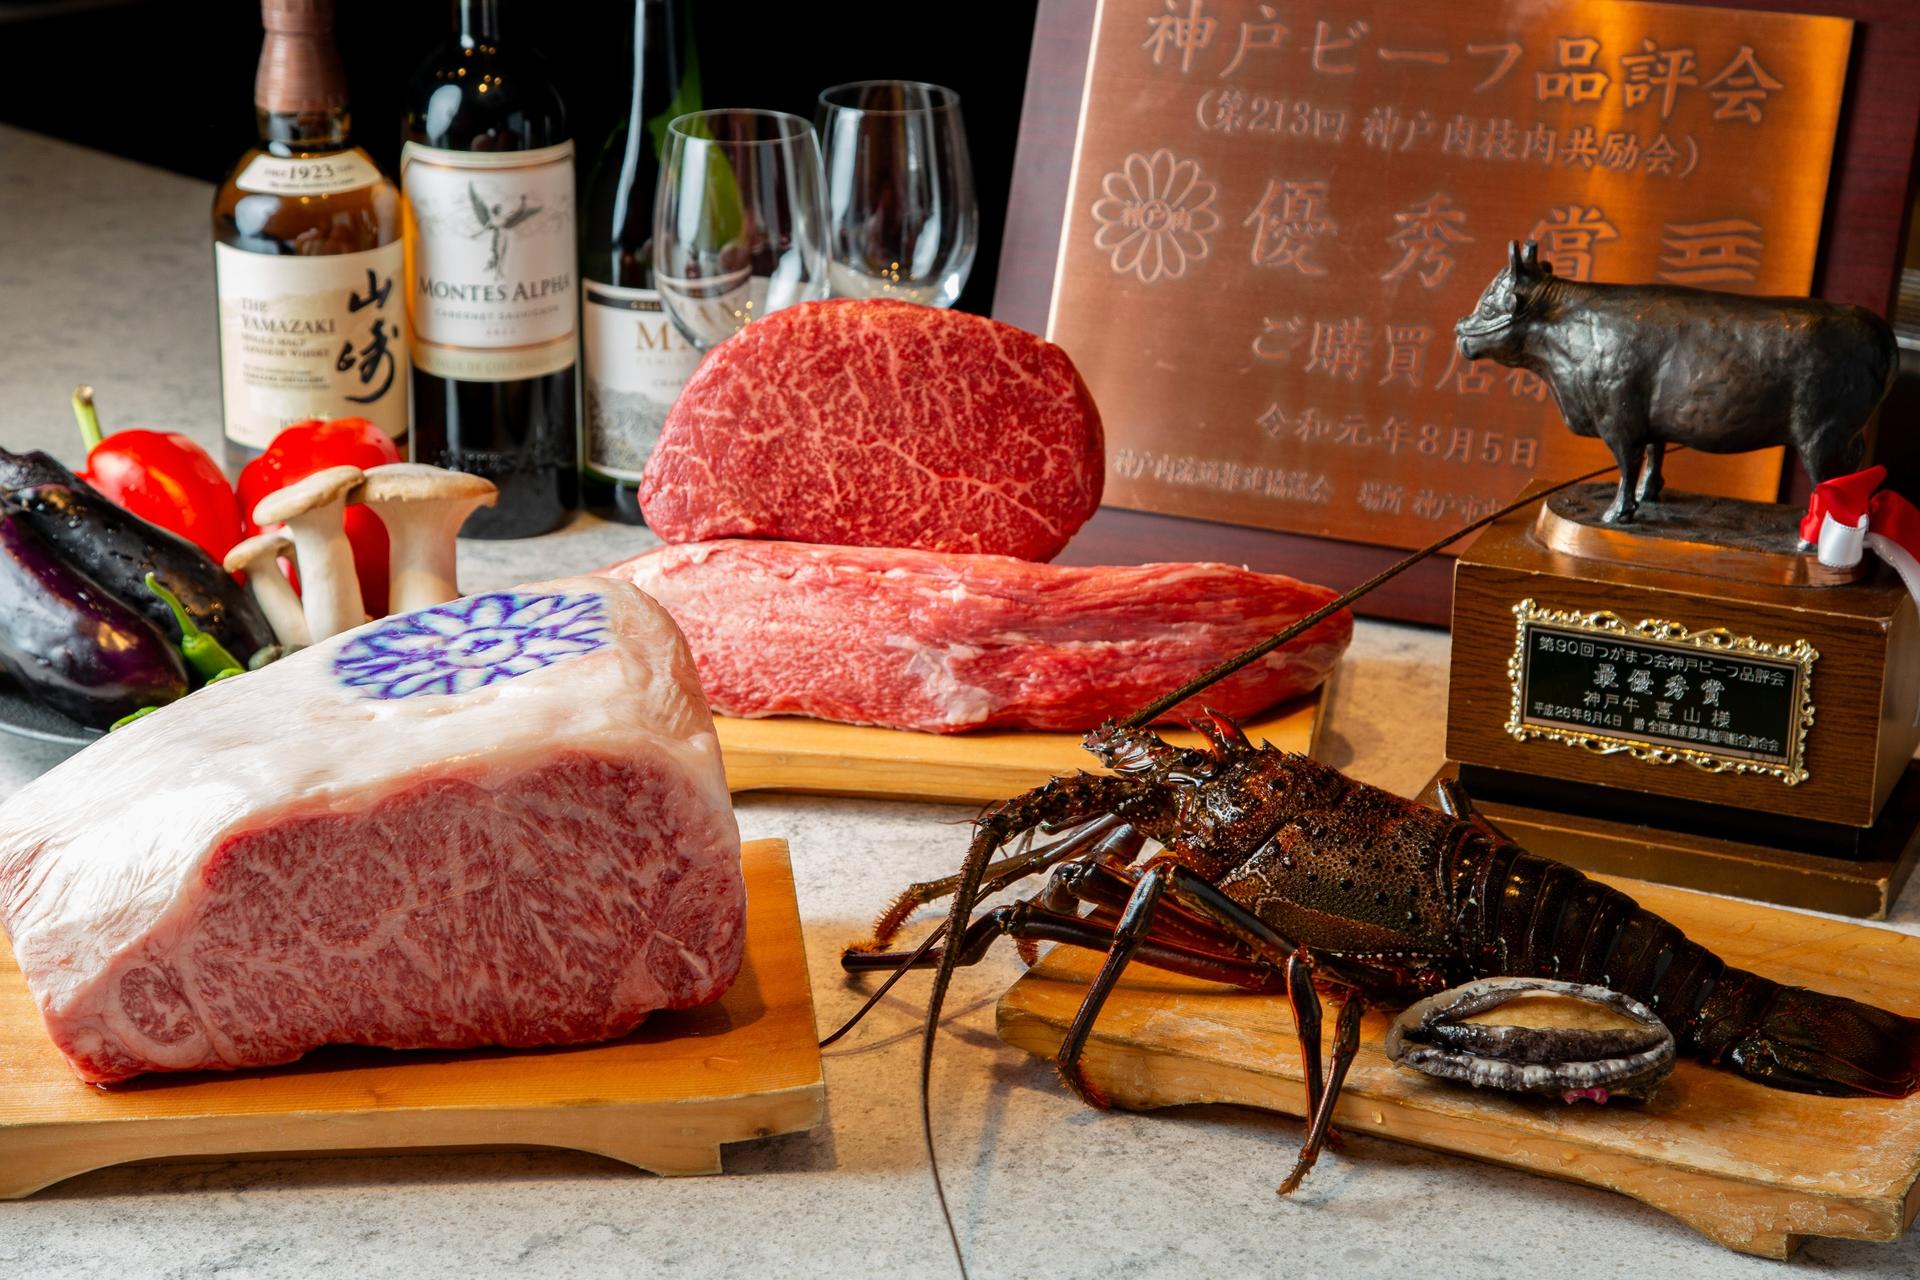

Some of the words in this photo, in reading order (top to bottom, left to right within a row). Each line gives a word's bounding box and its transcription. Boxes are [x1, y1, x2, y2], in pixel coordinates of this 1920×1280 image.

[1141, 0, 1784, 123] 神戸ビーフ品評会
[289, 163, 335, 179] 1923
[419, 274, 507, 302] MONTES
[241, 314, 337, 335] YAMAZAKI
[1256, 403, 1538, 469] 令和元年8月5日
[1593, 663, 1726, 707] 最優秀賞
